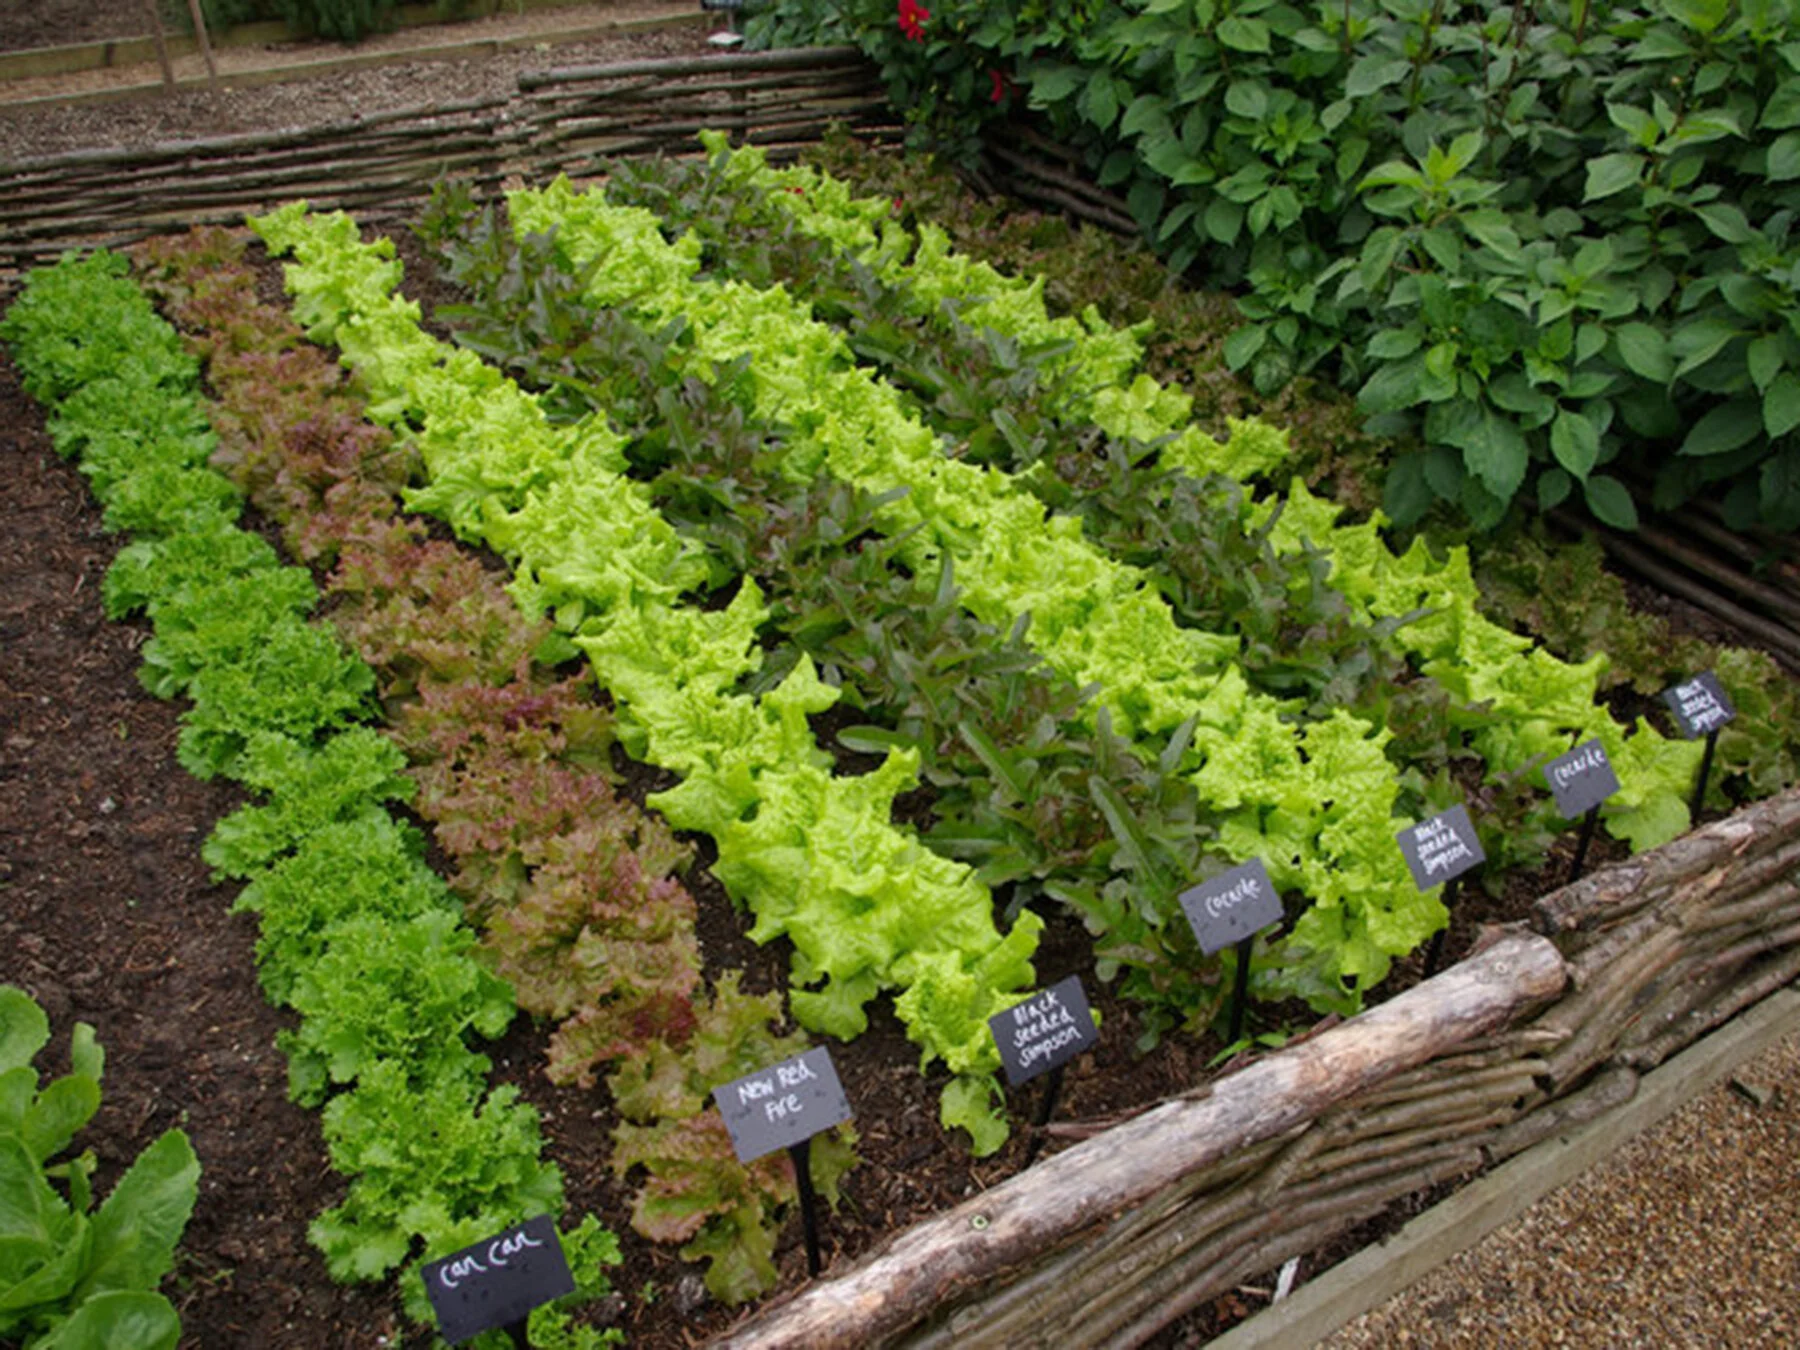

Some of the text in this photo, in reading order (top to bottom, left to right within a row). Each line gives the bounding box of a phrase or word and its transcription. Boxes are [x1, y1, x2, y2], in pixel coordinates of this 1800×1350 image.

[738, 1058, 818, 1105] New Red
[765, 1094, 803, 1122] Fire
